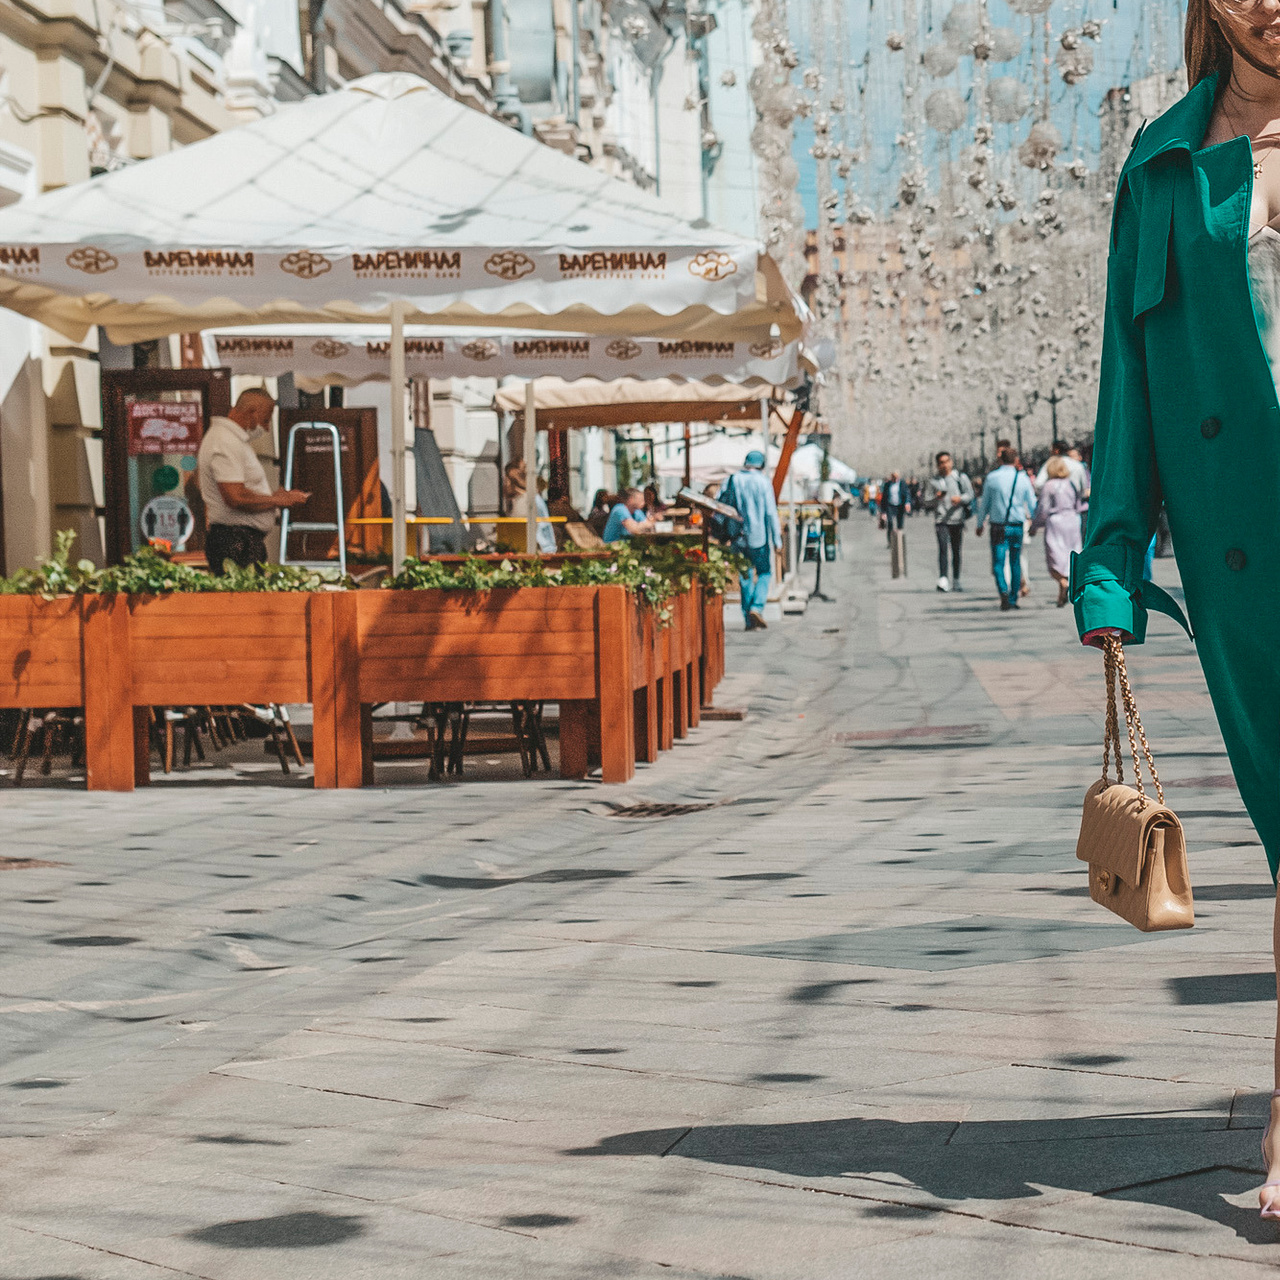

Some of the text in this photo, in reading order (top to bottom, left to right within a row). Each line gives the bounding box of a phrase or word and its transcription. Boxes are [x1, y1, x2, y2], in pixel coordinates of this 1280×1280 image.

[144, 250, 254, 268] ВАРЕНИЧНАЯ
[352, 251, 461, 270] ВАРЕНИЧНАЯ
[559, 252, 667, 271] ВАРЕНИЧНАЯ
